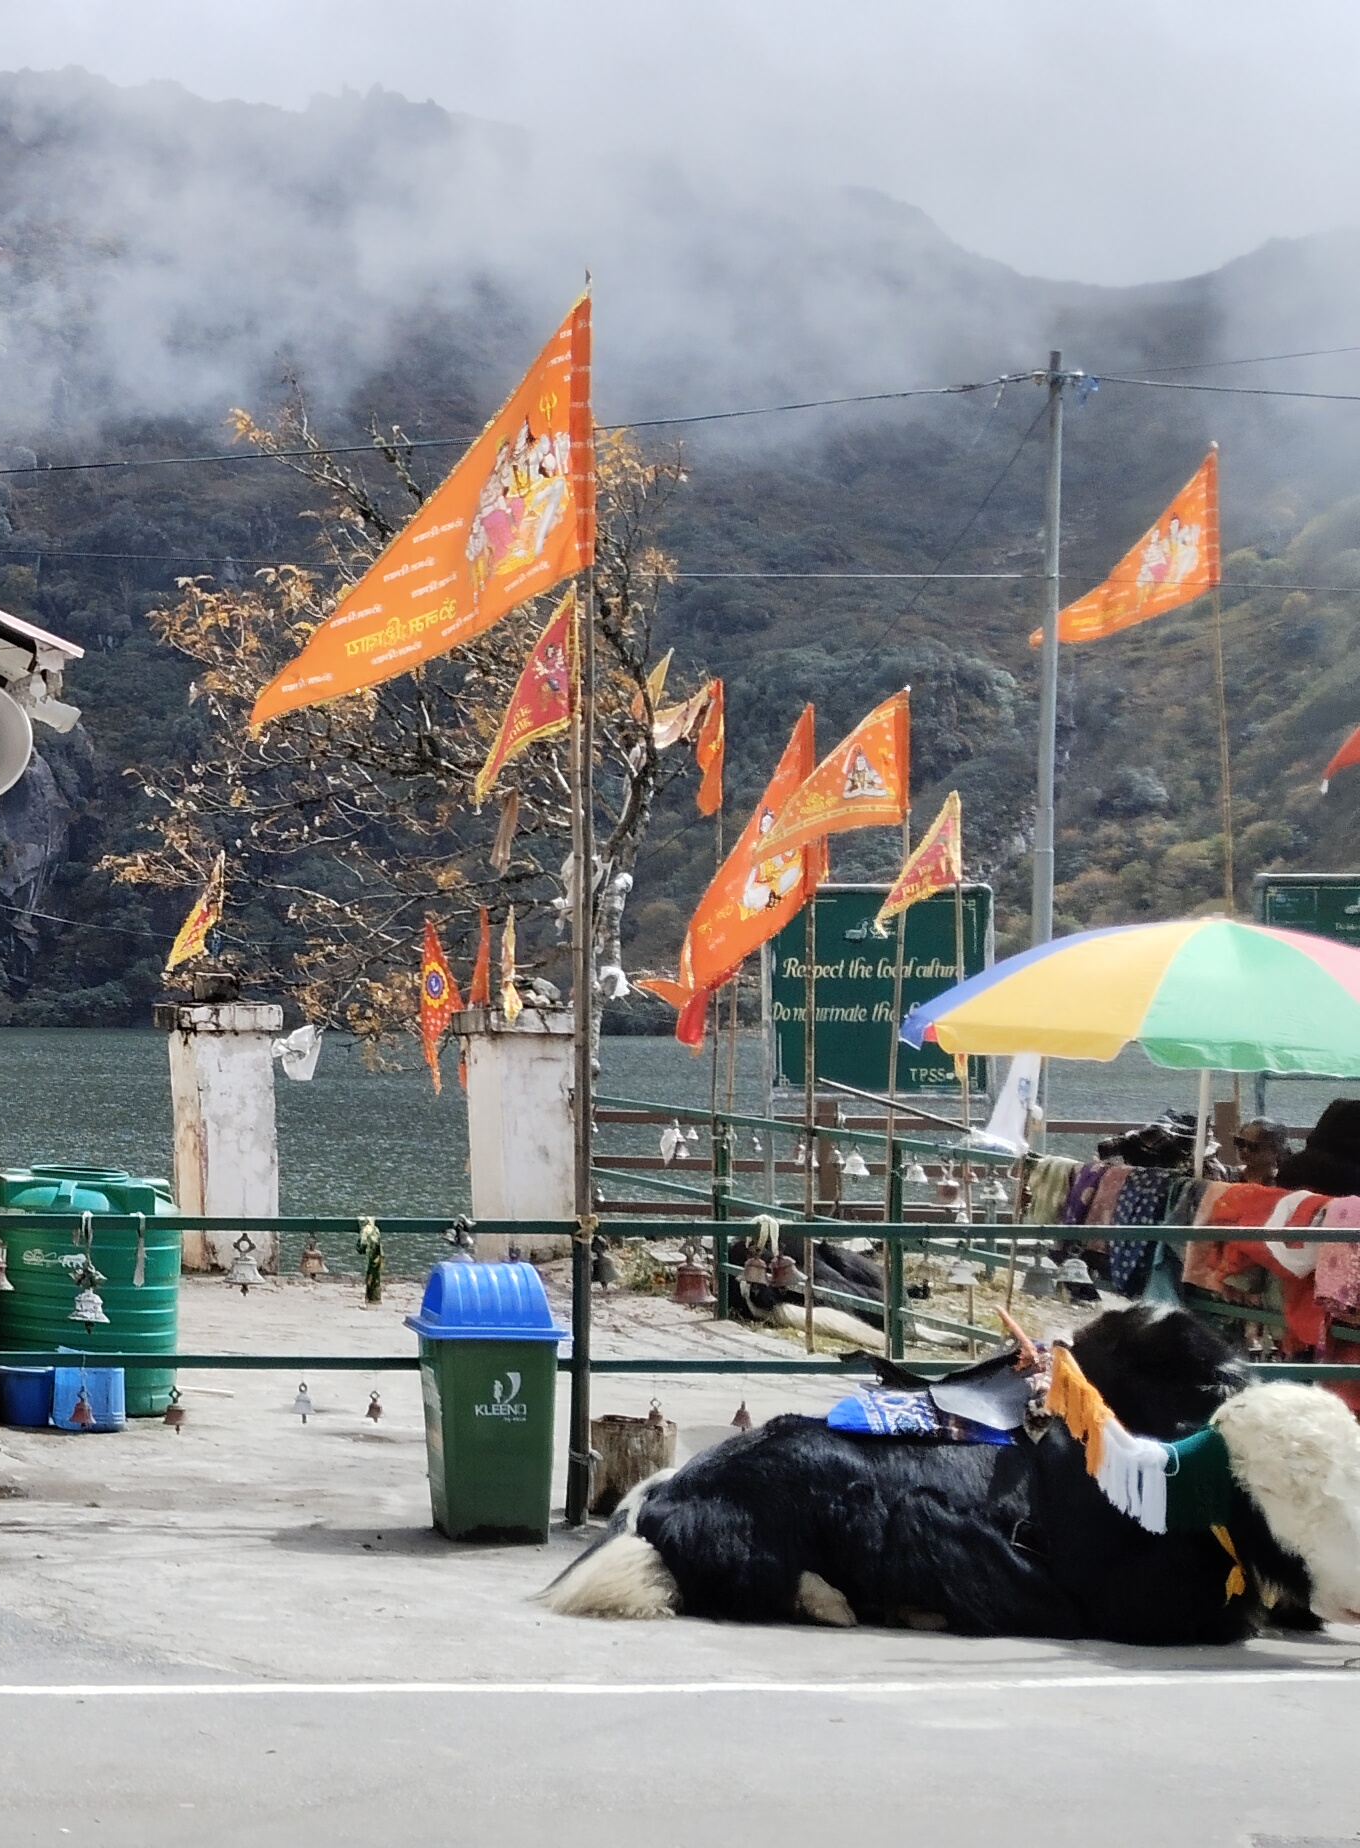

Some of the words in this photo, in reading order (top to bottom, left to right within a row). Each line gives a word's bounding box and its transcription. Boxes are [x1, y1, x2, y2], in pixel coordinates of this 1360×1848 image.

[782, 957, 844, 978] Repect
[848, 957, 873, 978] the
[916, 957, 965, 979] cultur
[773, 1001, 791, 1022] Do
[792, 1007, 814, 1022] no
